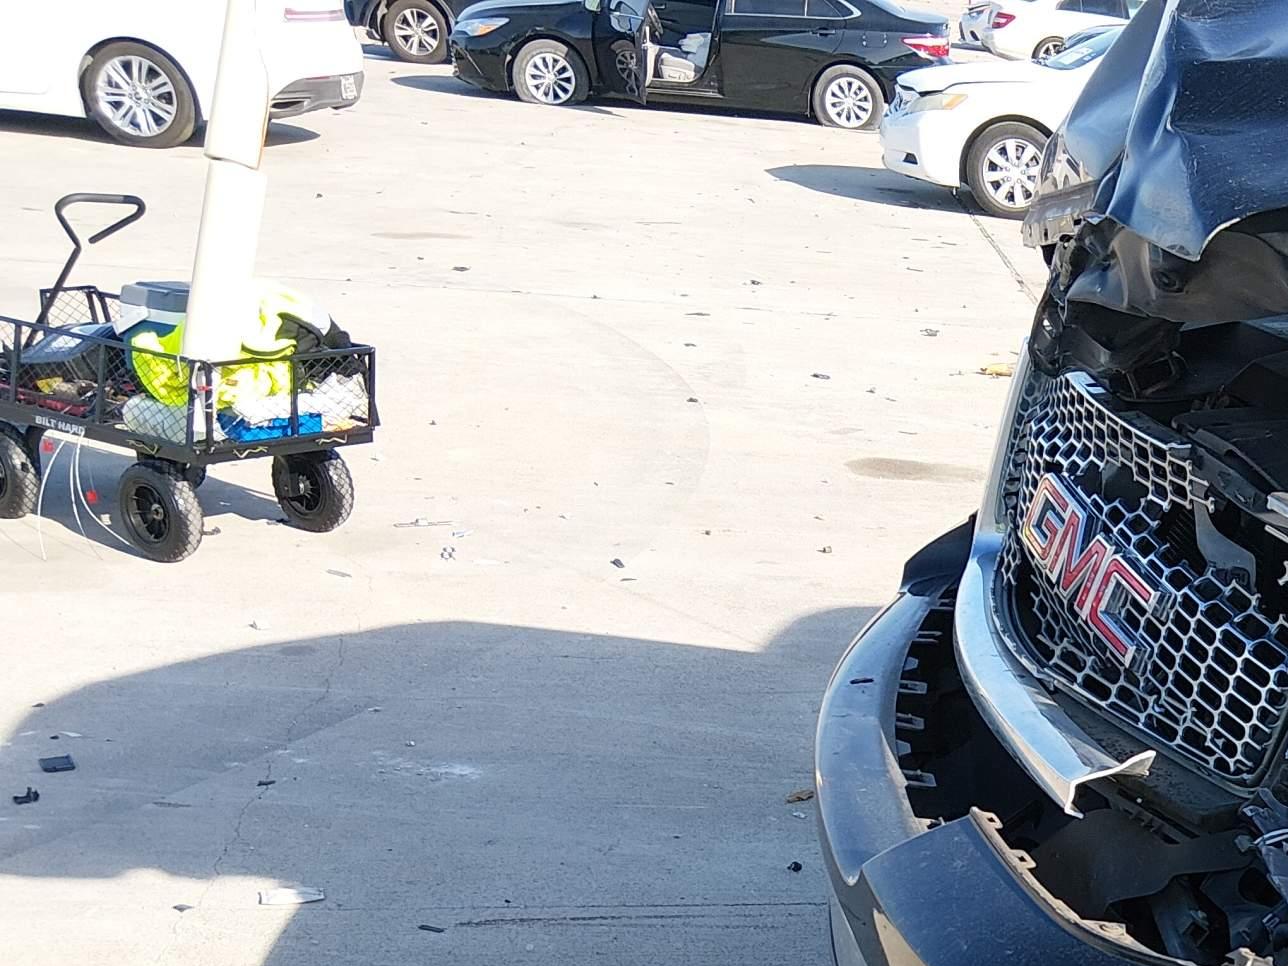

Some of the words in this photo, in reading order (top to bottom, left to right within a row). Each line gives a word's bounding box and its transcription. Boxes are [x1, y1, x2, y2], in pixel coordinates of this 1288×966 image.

[35, 415, 57, 428] BILT
[57, 421, 85, 435] HARD
[1022, 472, 1159, 669] GMC
